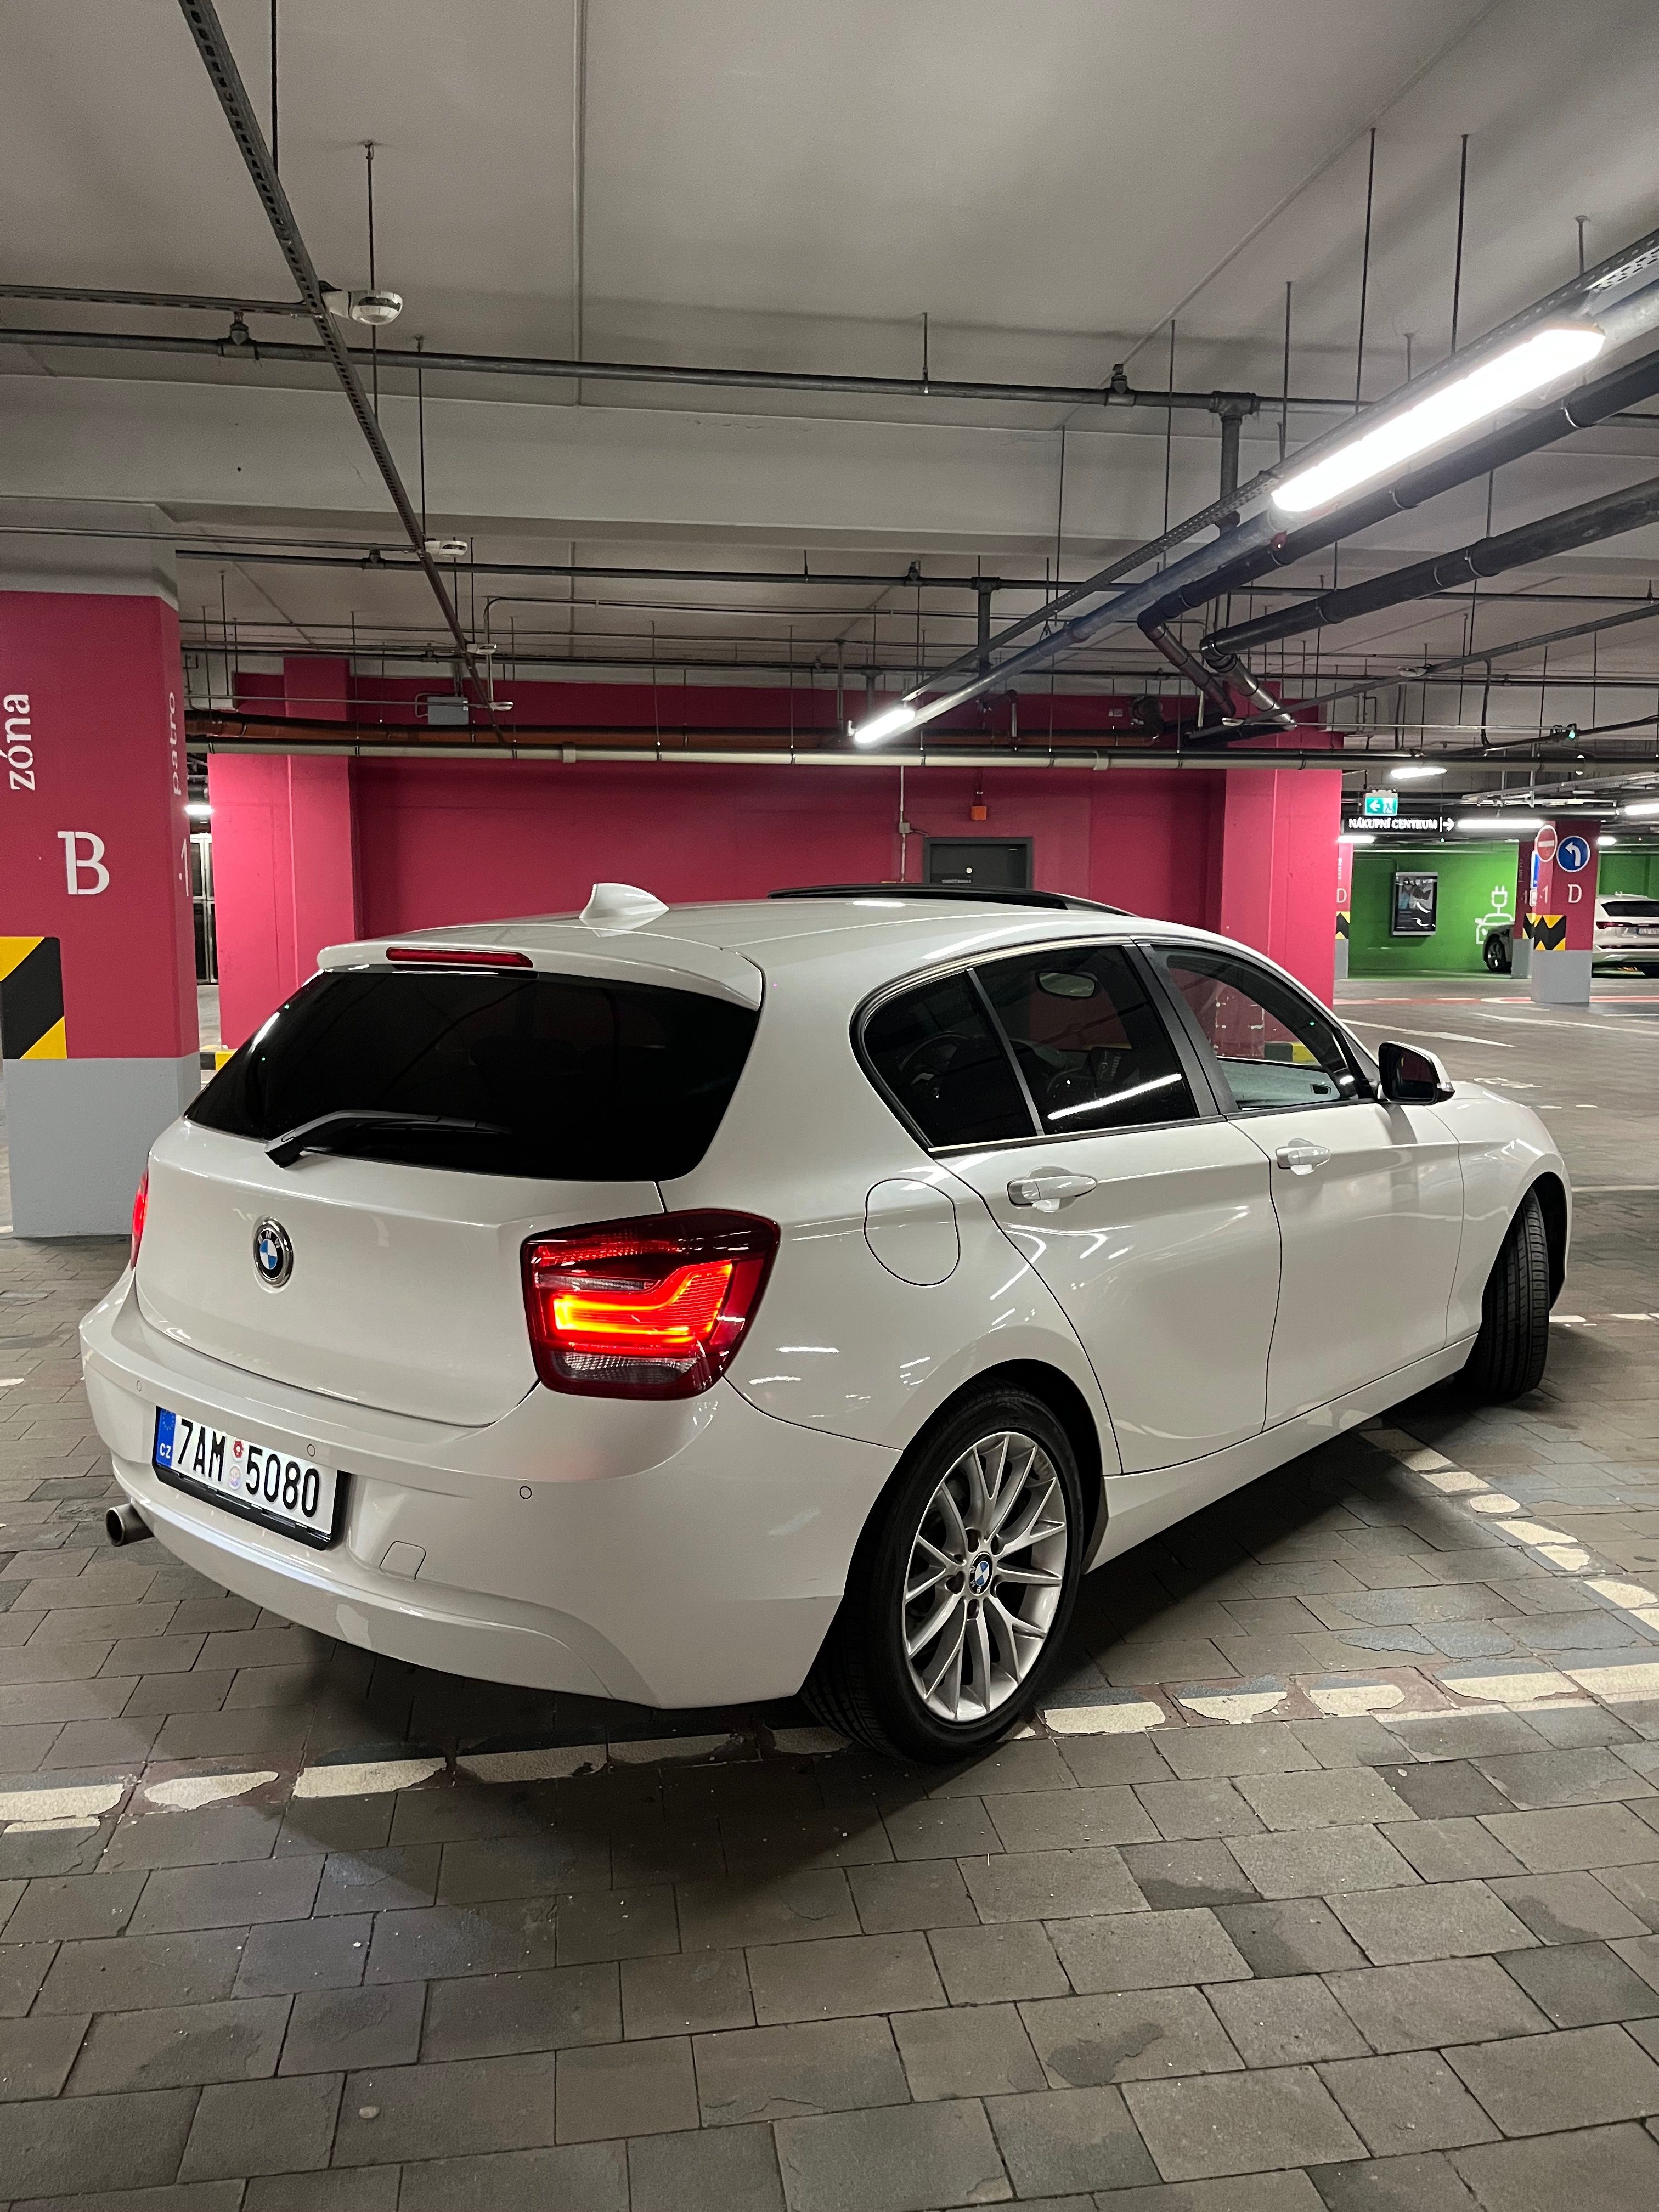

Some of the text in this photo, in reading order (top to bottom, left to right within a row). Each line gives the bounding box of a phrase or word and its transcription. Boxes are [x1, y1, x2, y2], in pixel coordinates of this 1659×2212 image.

[0, 693, 36, 791] zóna
[169, 691, 182, 795] patro
[1348, 817, 1437, 830] NÁKUPNÍ CENTRUM
[57, 831, 110, 895] B
[1336, 887, 1347, 904] D
[1567, 883, 1583, 904] D
[159, 1442, 172, 1459] CZ
[178, 1418, 320, 1518] 7AM 5080
